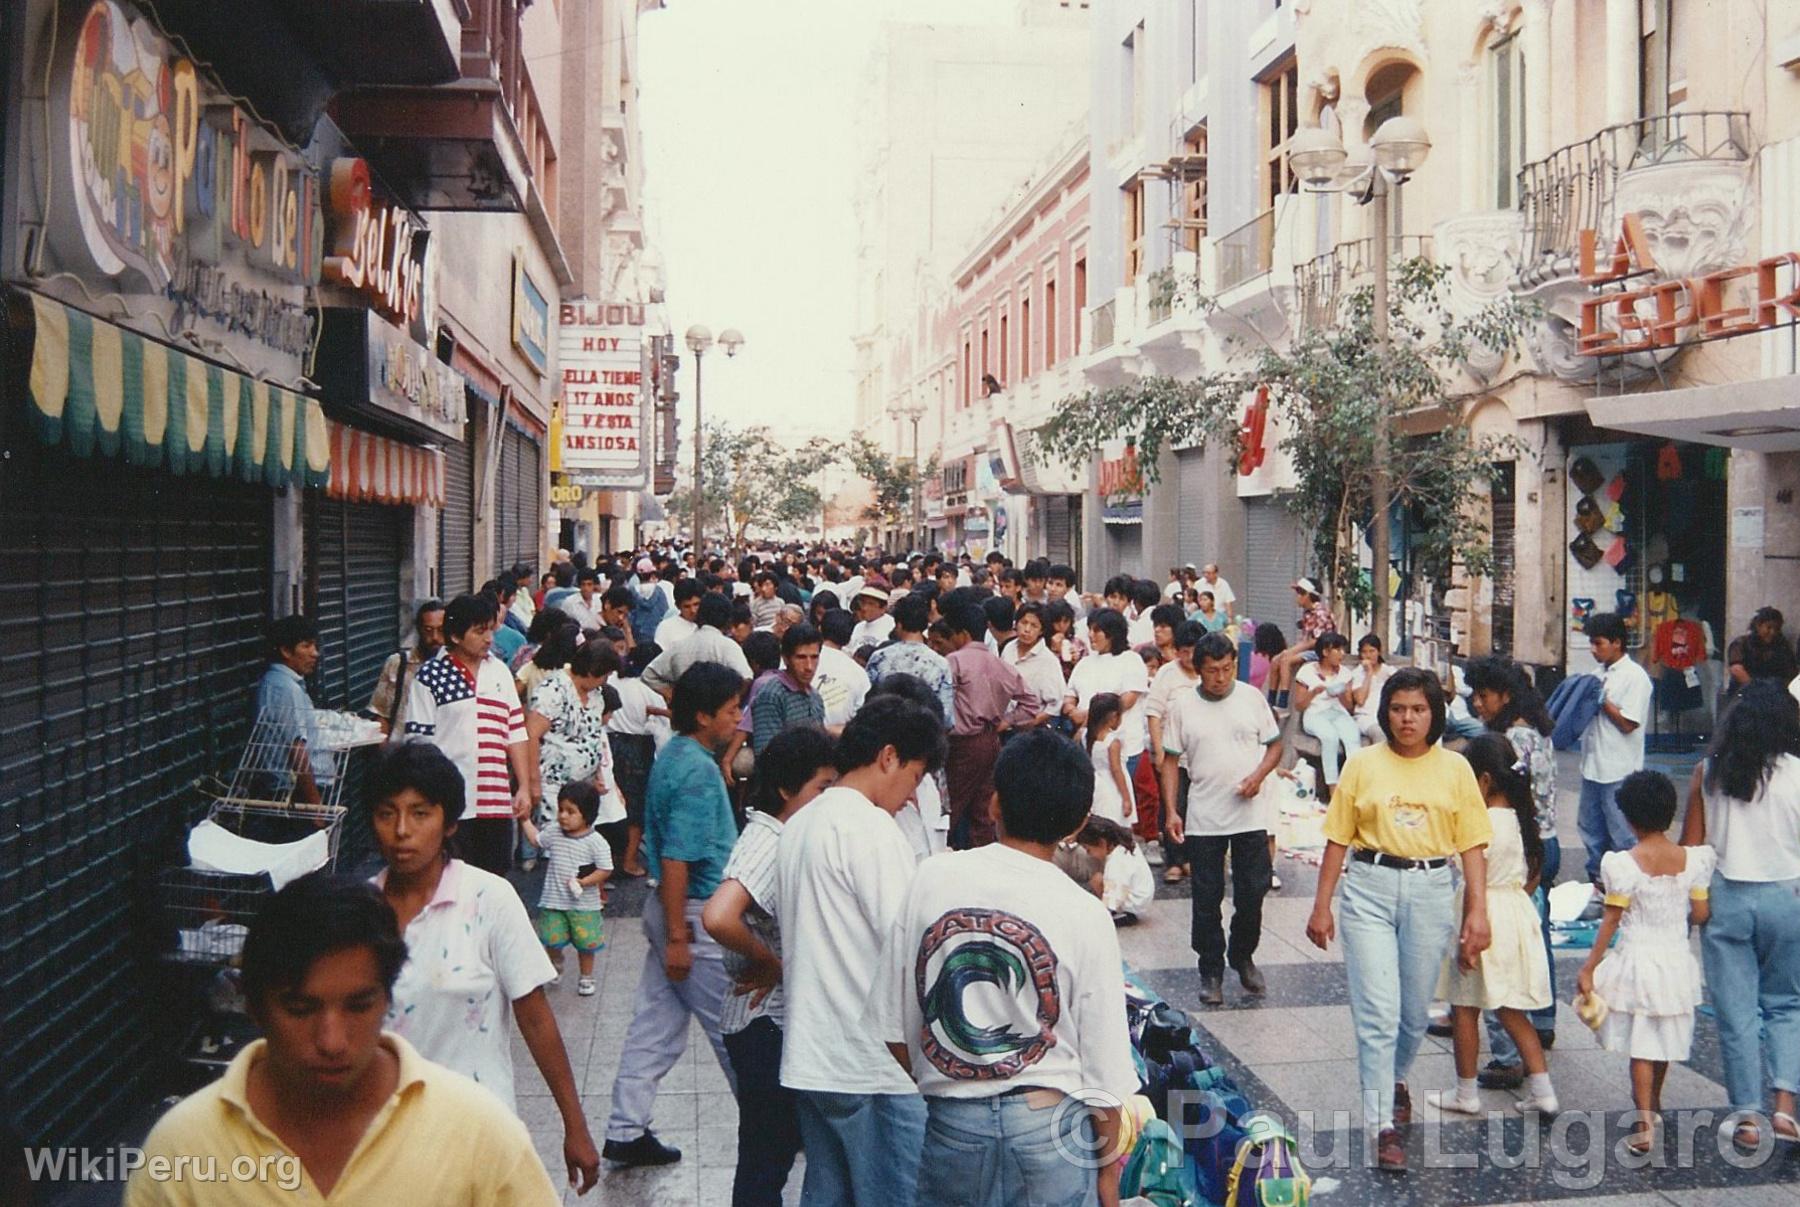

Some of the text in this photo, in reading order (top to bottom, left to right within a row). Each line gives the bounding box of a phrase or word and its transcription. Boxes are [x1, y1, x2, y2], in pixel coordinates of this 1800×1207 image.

[1579, 212, 1656, 284] LA
[560, 304, 645, 326] BIJOU
[583, 337, 620, 352] HOY
[564, 369, 598, 384] ELLA
[574, 391, 589, 405] 17
